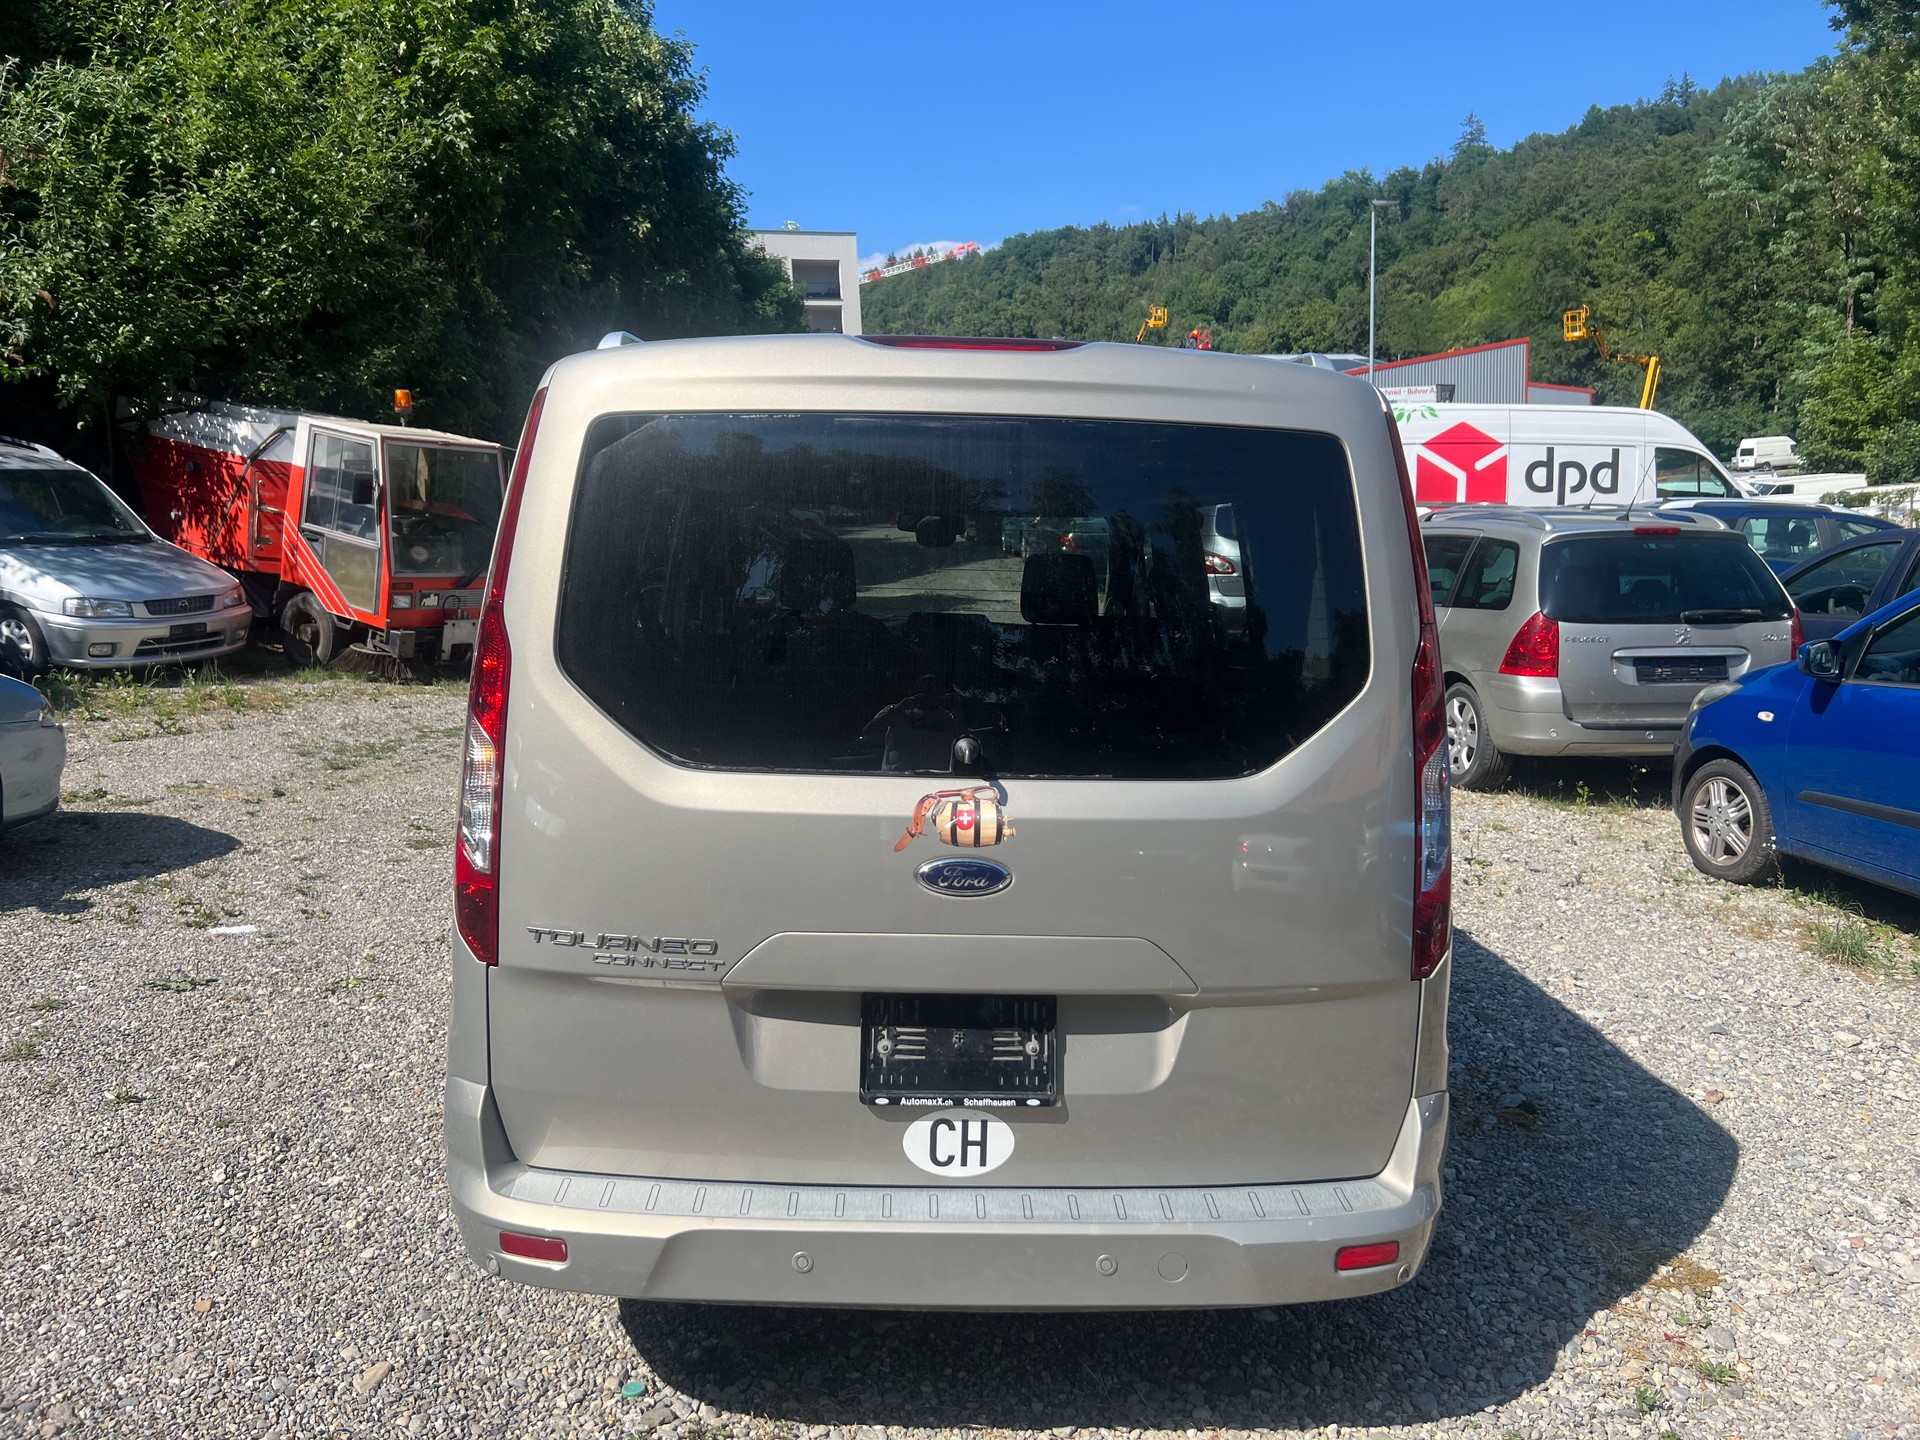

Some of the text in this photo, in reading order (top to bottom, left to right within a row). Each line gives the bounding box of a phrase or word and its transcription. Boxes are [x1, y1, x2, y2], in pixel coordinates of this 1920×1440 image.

[1524, 446, 1620, 506] dpd
[1564, 635, 1610, 643] PEUGEOT
[937, 865, 989, 888] Ford
[526, 926, 719, 956] TOURNEO
[592, 952, 726, 972] CONNECT
[900, 1097, 1017, 1107] AutomaxX.ch Schaffhausen
[929, 1117, 989, 1167] CH
